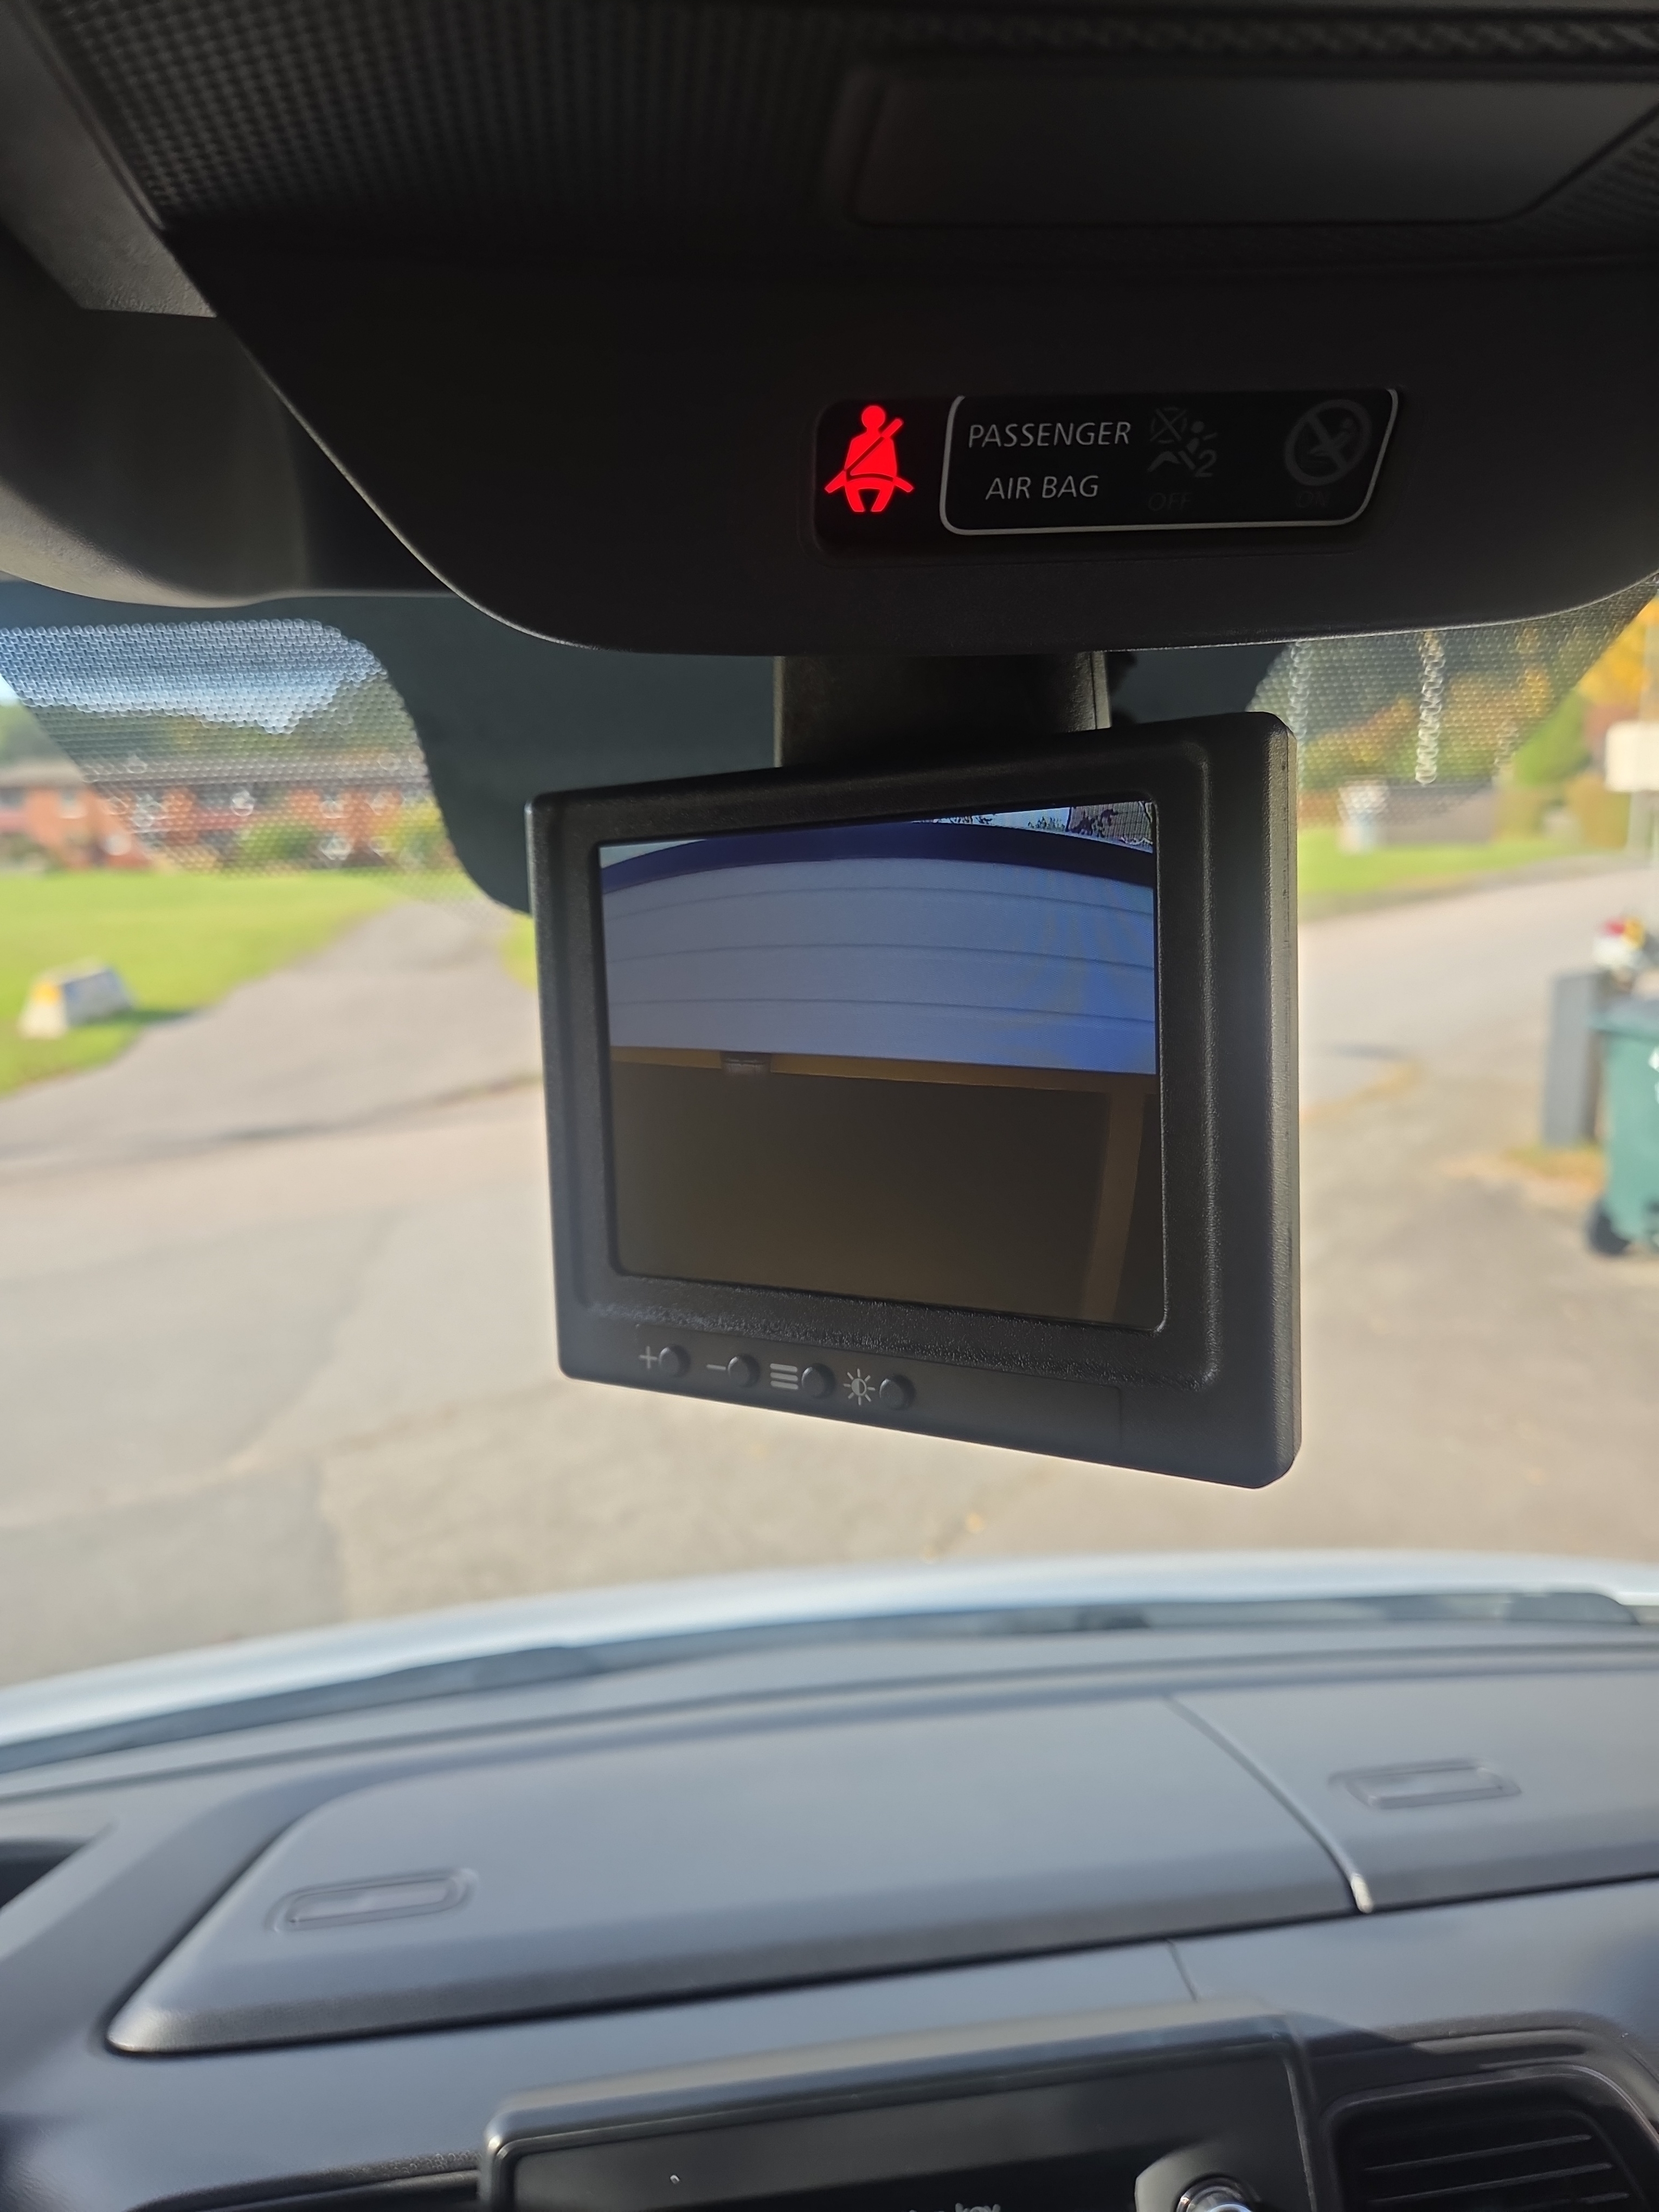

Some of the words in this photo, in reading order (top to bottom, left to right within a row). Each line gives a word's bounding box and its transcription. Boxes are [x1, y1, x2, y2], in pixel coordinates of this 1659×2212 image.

[968, 421, 1131, 448] PASSENGER
[985, 476, 1032, 500] AIR
[1041, 474, 1099, 499] BAG
[1148, 492, 1192, 511] OFF
